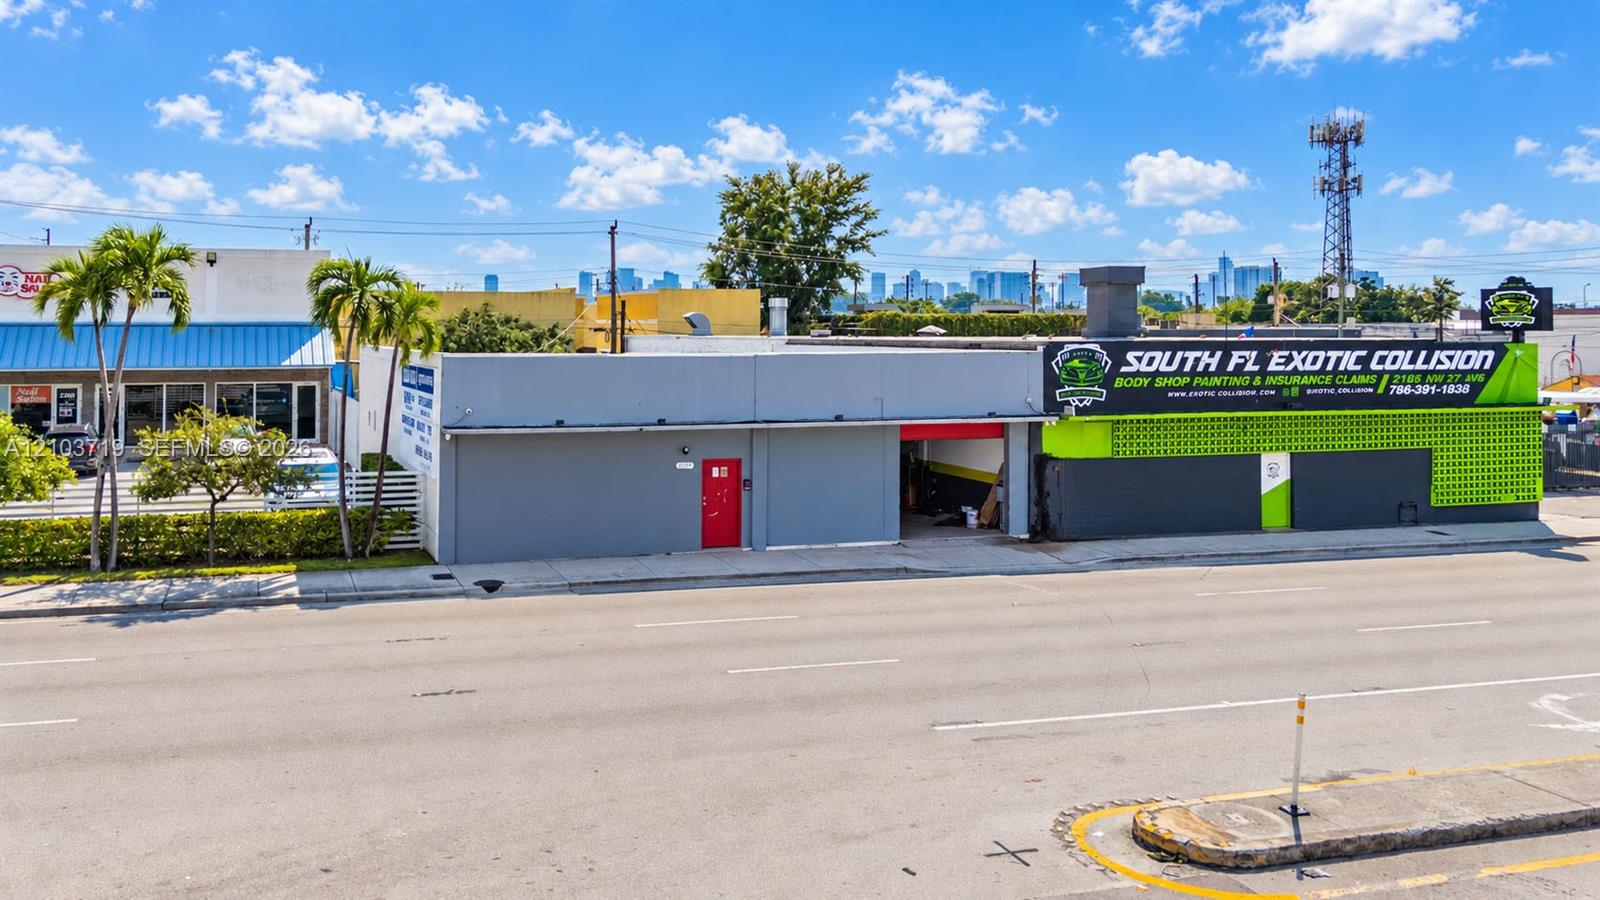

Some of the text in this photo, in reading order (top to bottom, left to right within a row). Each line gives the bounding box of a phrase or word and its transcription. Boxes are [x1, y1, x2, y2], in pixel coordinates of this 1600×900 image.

[1120, 349, 1495, 373] SOUTH FL EXOTIC COLLISION
[1114, 374, 1378, 388] BODY SHOP PAINTING & INSURANCE CLAIMS
[1425, 373, 1445, 384] NW
[1447, 373, 1461, 384] 27
[1389, 383, 1470, 395] 786-391-1838
